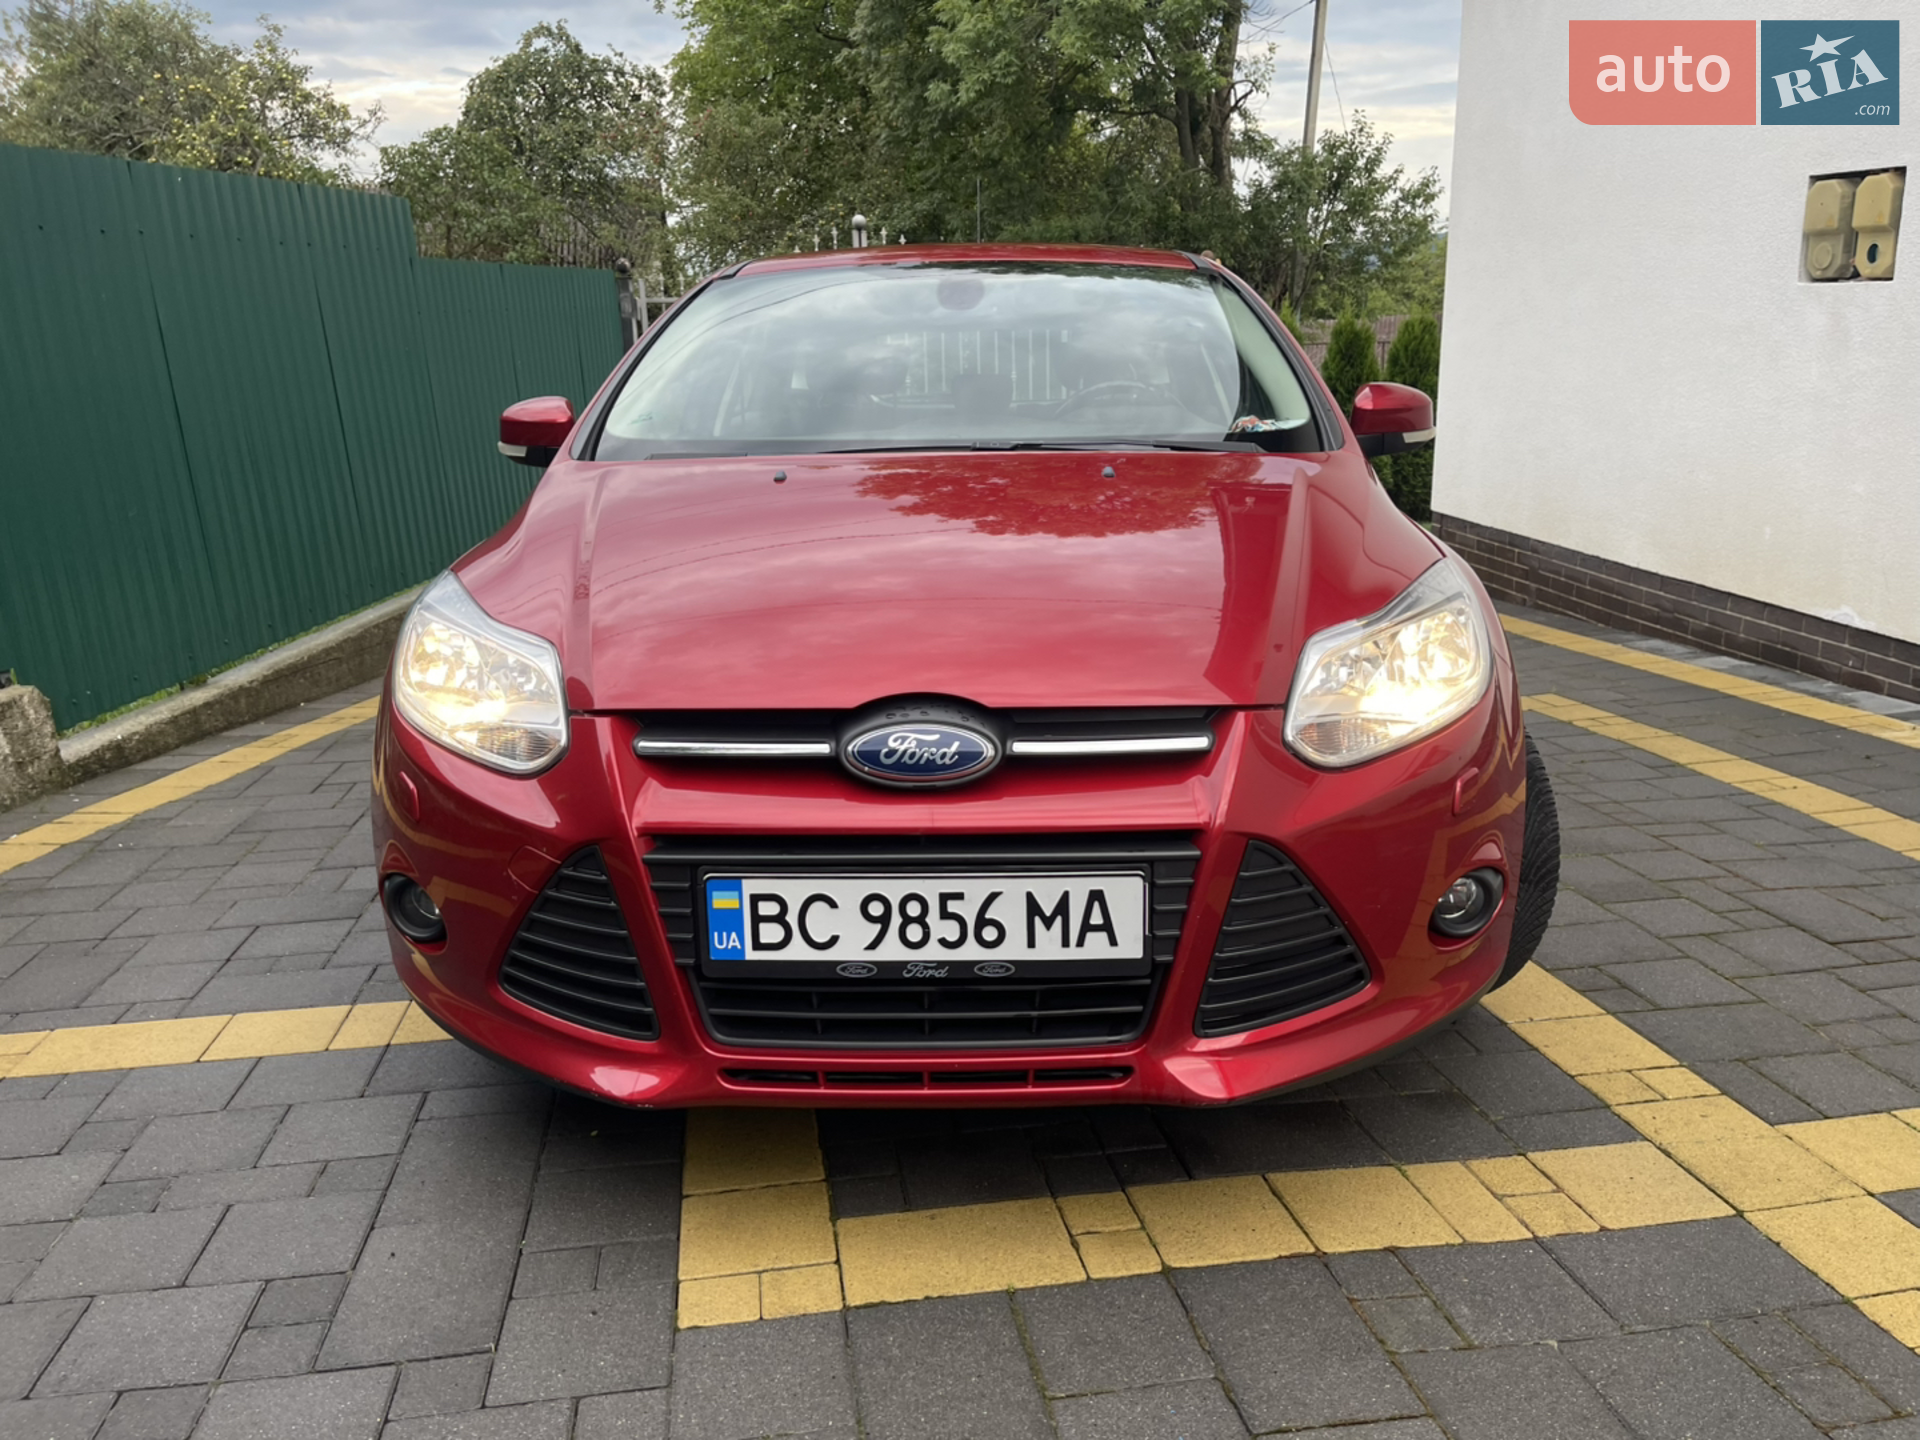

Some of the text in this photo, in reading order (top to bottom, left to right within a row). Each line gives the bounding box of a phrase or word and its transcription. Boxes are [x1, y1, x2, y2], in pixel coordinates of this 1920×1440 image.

[879, 732, 960, 765] Ford
[749, 889, 1119, 951] BC 9856 MA
[713, 931, 742, 950] UA
[844, 965, 868, 975] Ford
[902, 962, 949, 978] Ford
[982, 964, 1007, 974] Ford
